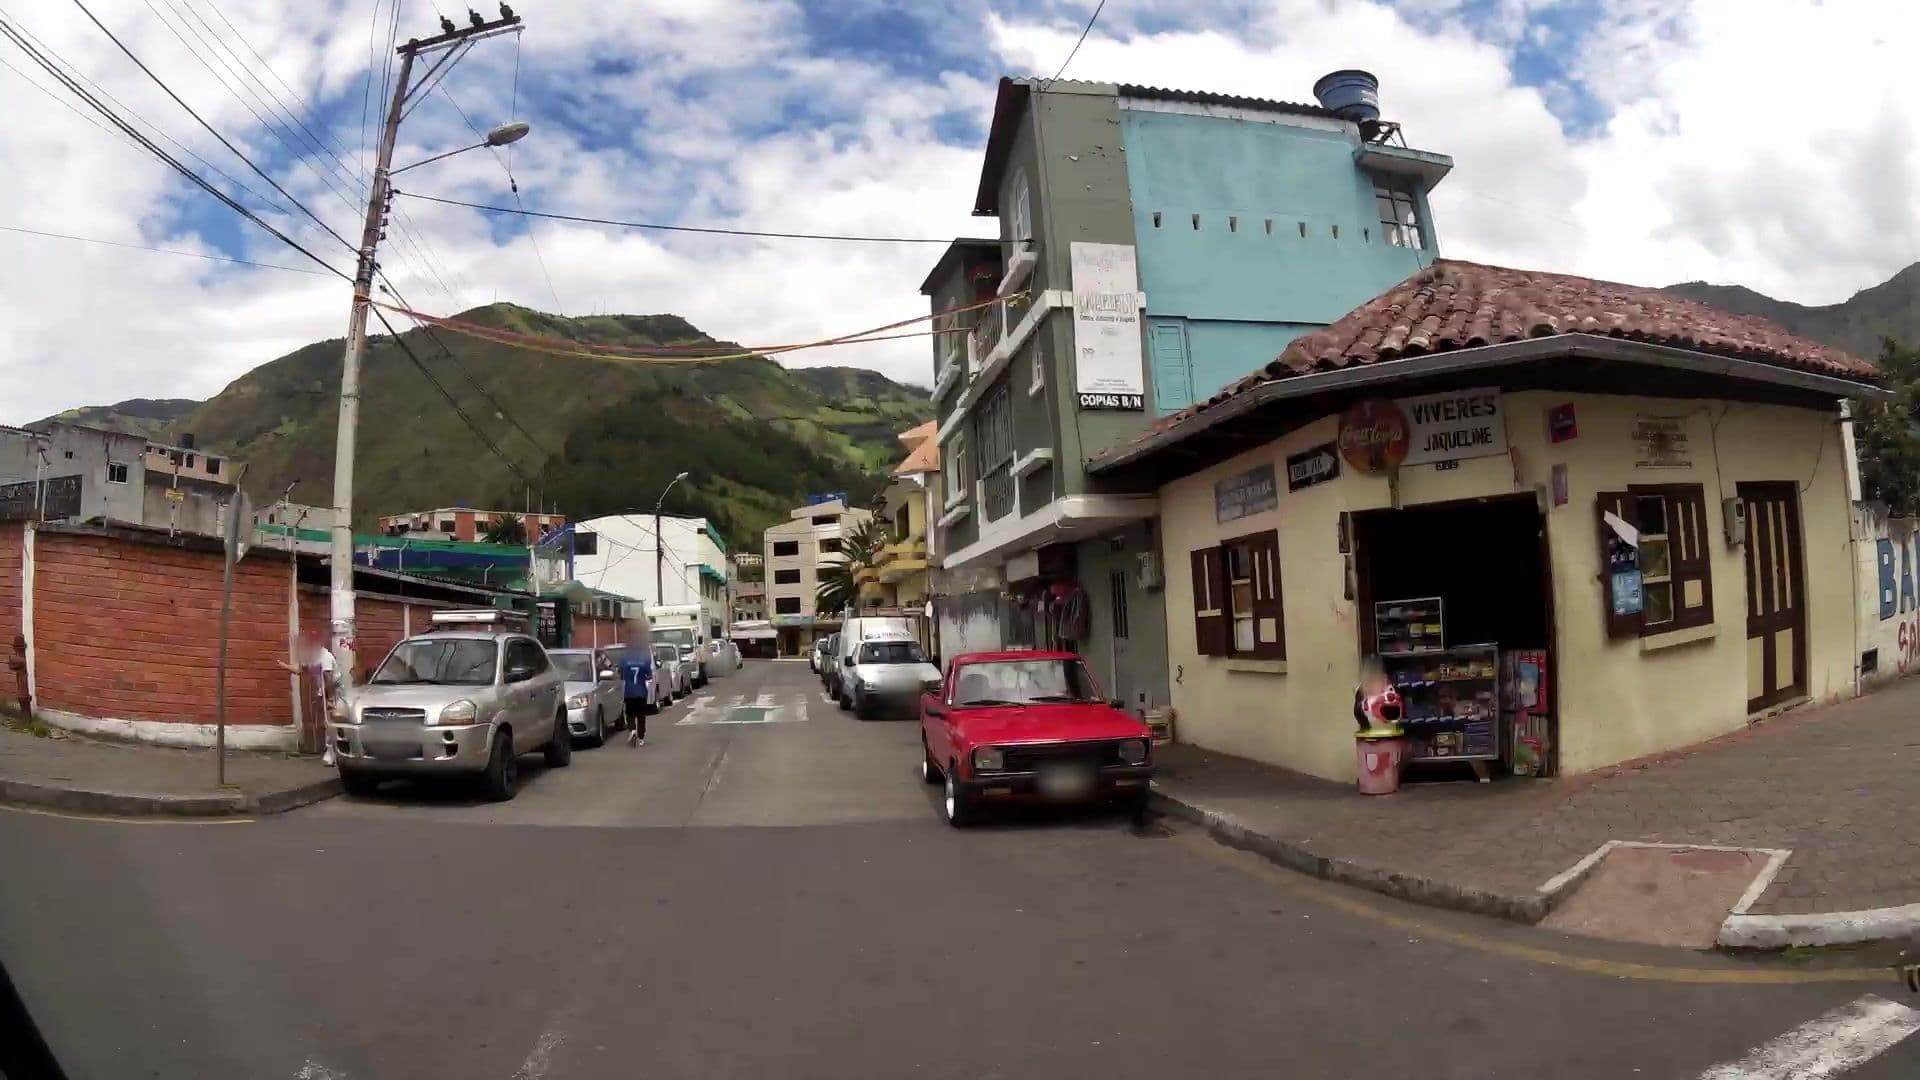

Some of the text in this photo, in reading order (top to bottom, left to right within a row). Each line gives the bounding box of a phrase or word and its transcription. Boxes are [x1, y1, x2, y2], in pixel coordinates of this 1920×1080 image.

[1080, 394, 1142, 408] COPIAS B/N
[1412, 394, 1497, 425] VIVERES
[630, 666, 640, 685] 7
